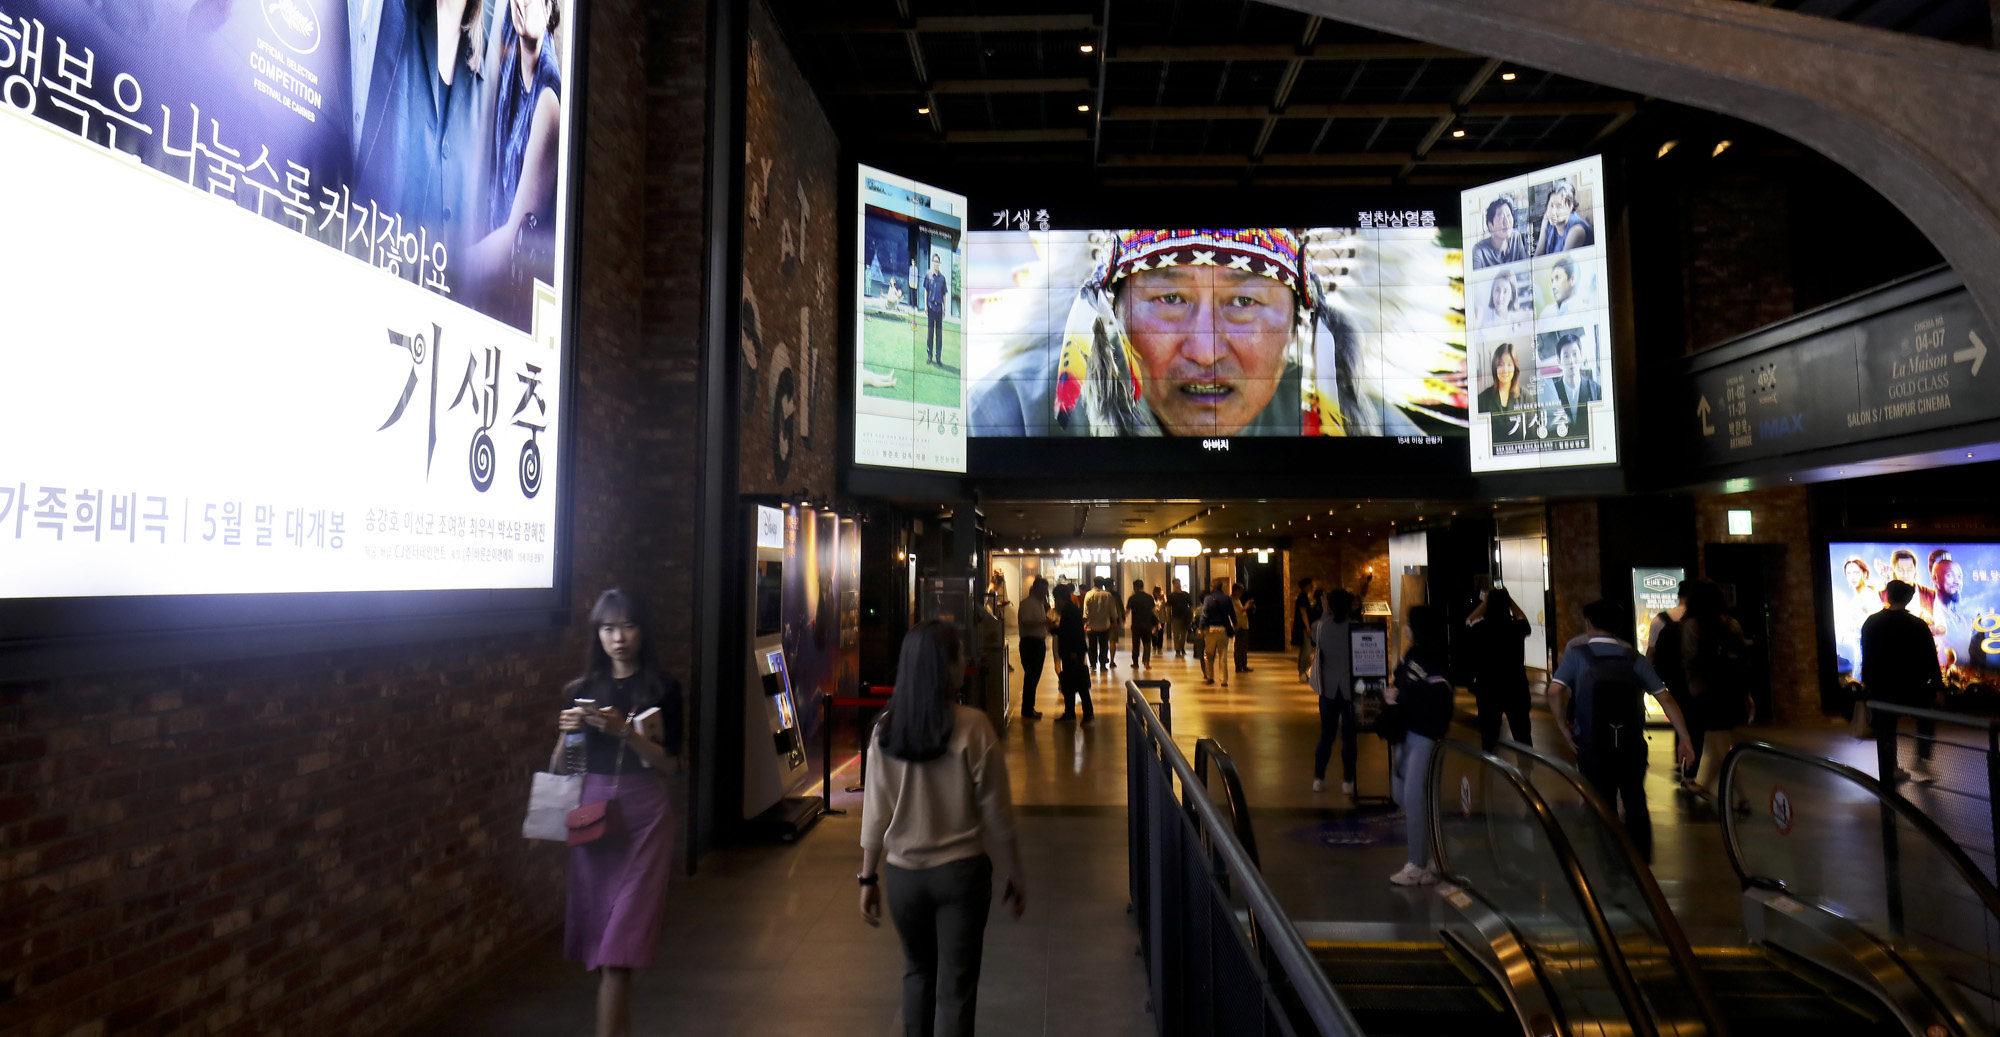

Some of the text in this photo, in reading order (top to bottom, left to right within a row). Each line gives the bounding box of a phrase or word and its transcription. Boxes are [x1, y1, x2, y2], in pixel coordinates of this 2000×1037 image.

[257, 37, 318, 86] OFFICIAL SELECTION
[250, 51, 321, 110] COMPETITION
[254, 77, 316, 123] FESTIVAL DE CANNES
[0, 13, 451, 293] 행복은 나눌수록 커지잖아요
[992, 209, 1050, 231] 기생충
[1358, 210, 1436, 228] 절찬상영중
[1914, 319, 1934, 332] CINEMA
[1915, 329, 1945, 352] 04-07
[1892, 353, 1947, 379] La Maison
[1888, 372, 1949, 399] GOLD CLASS
[376, 322, 550, 499] 기생충
[917, 408, 959, 437] 기생충
[1508, 409, 1571, 440] 기생충
[1847, 409, 1871, 428] SALON
[1872, 408, 1878, 423] S
[1884, 400, 1916, 420] TEMPUR
[1918, 393, 1951, 413] CINEMA
[1760, 413, 1804, 440] IMAX
[1203, 439, 1229, 451] 아버지
[0, 482, 346, 550] 가족희비극 5월 말 대개봉
[365, 507, 545, 542] 송강호 이선균 조여정 최우식 박소담 장혜진
